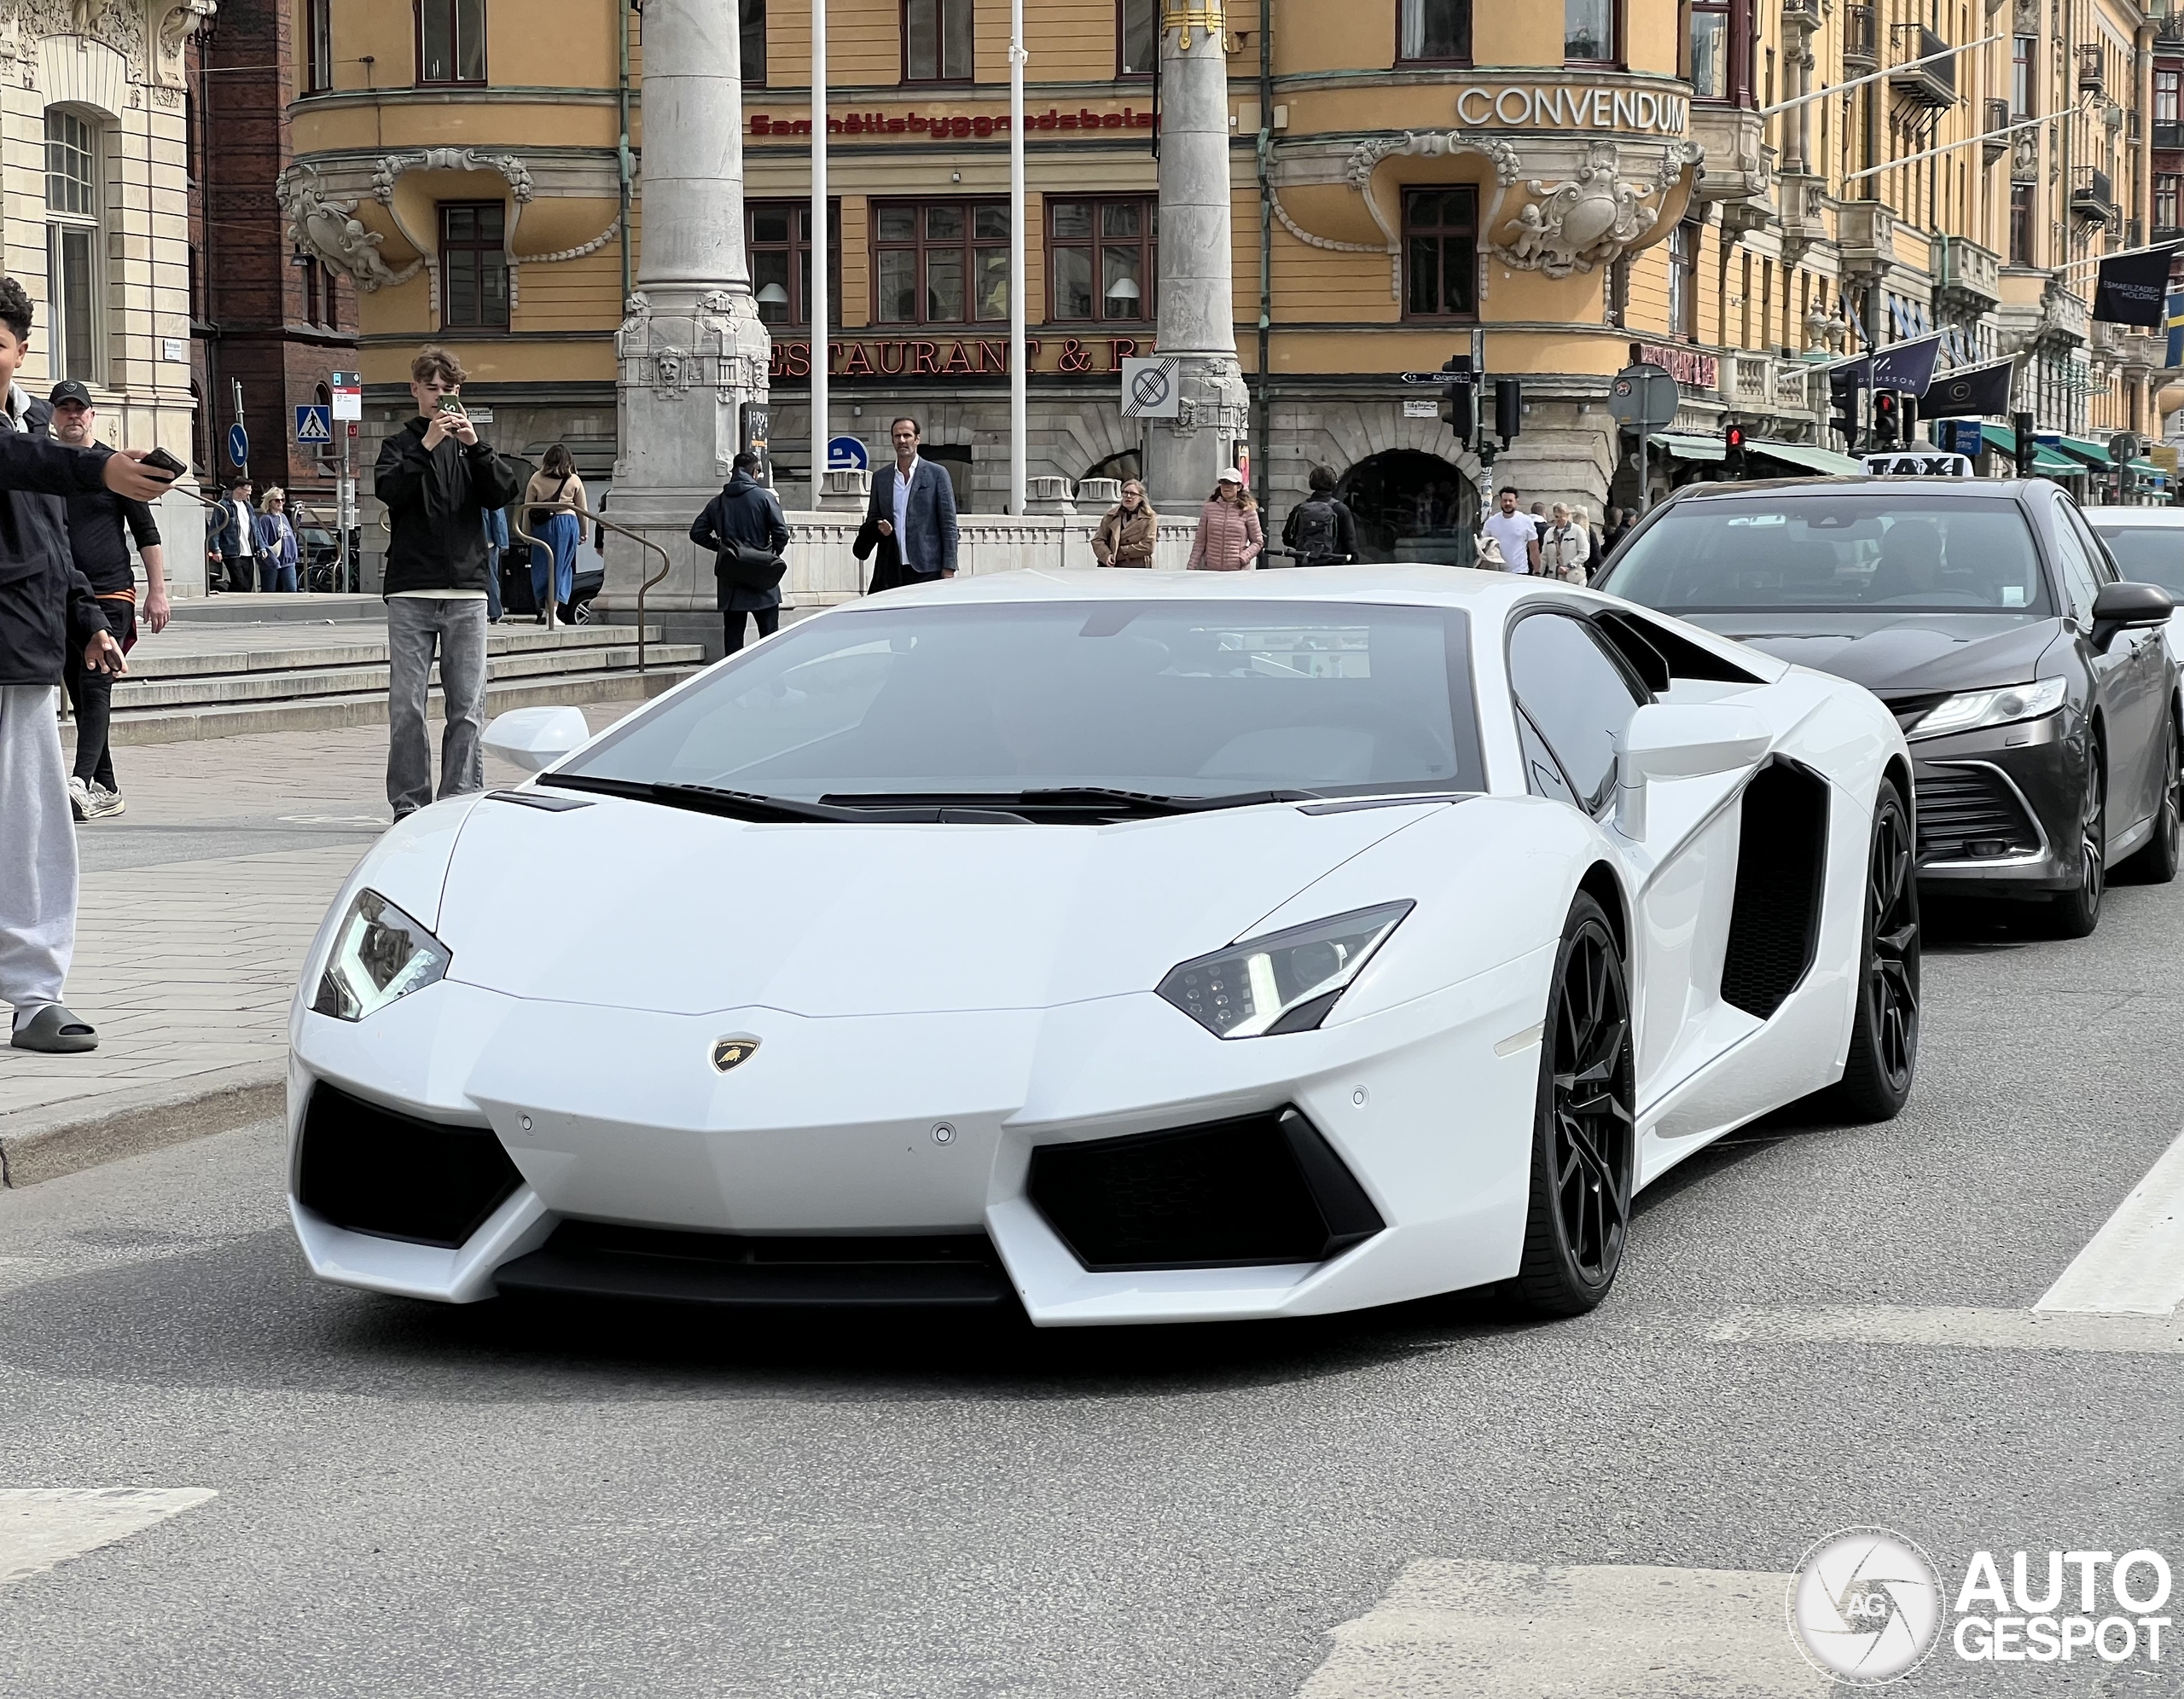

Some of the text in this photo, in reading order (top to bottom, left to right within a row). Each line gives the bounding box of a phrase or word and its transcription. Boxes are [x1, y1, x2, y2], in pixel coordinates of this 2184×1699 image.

[1457, 86, 1686, 133] CONVENDUM
[751, 107, 1162, 139] Samhällsbyggnadsbola
[2103, 280, 2160, 293] ESMAEILZADEH
[2122, 291, 2159, 301] HOLDING
[769, 339, 1041, 376] ESTAURANT
[1059, 338, 1092, 372] &
[1867, 457, 1965, 475] TAXI
